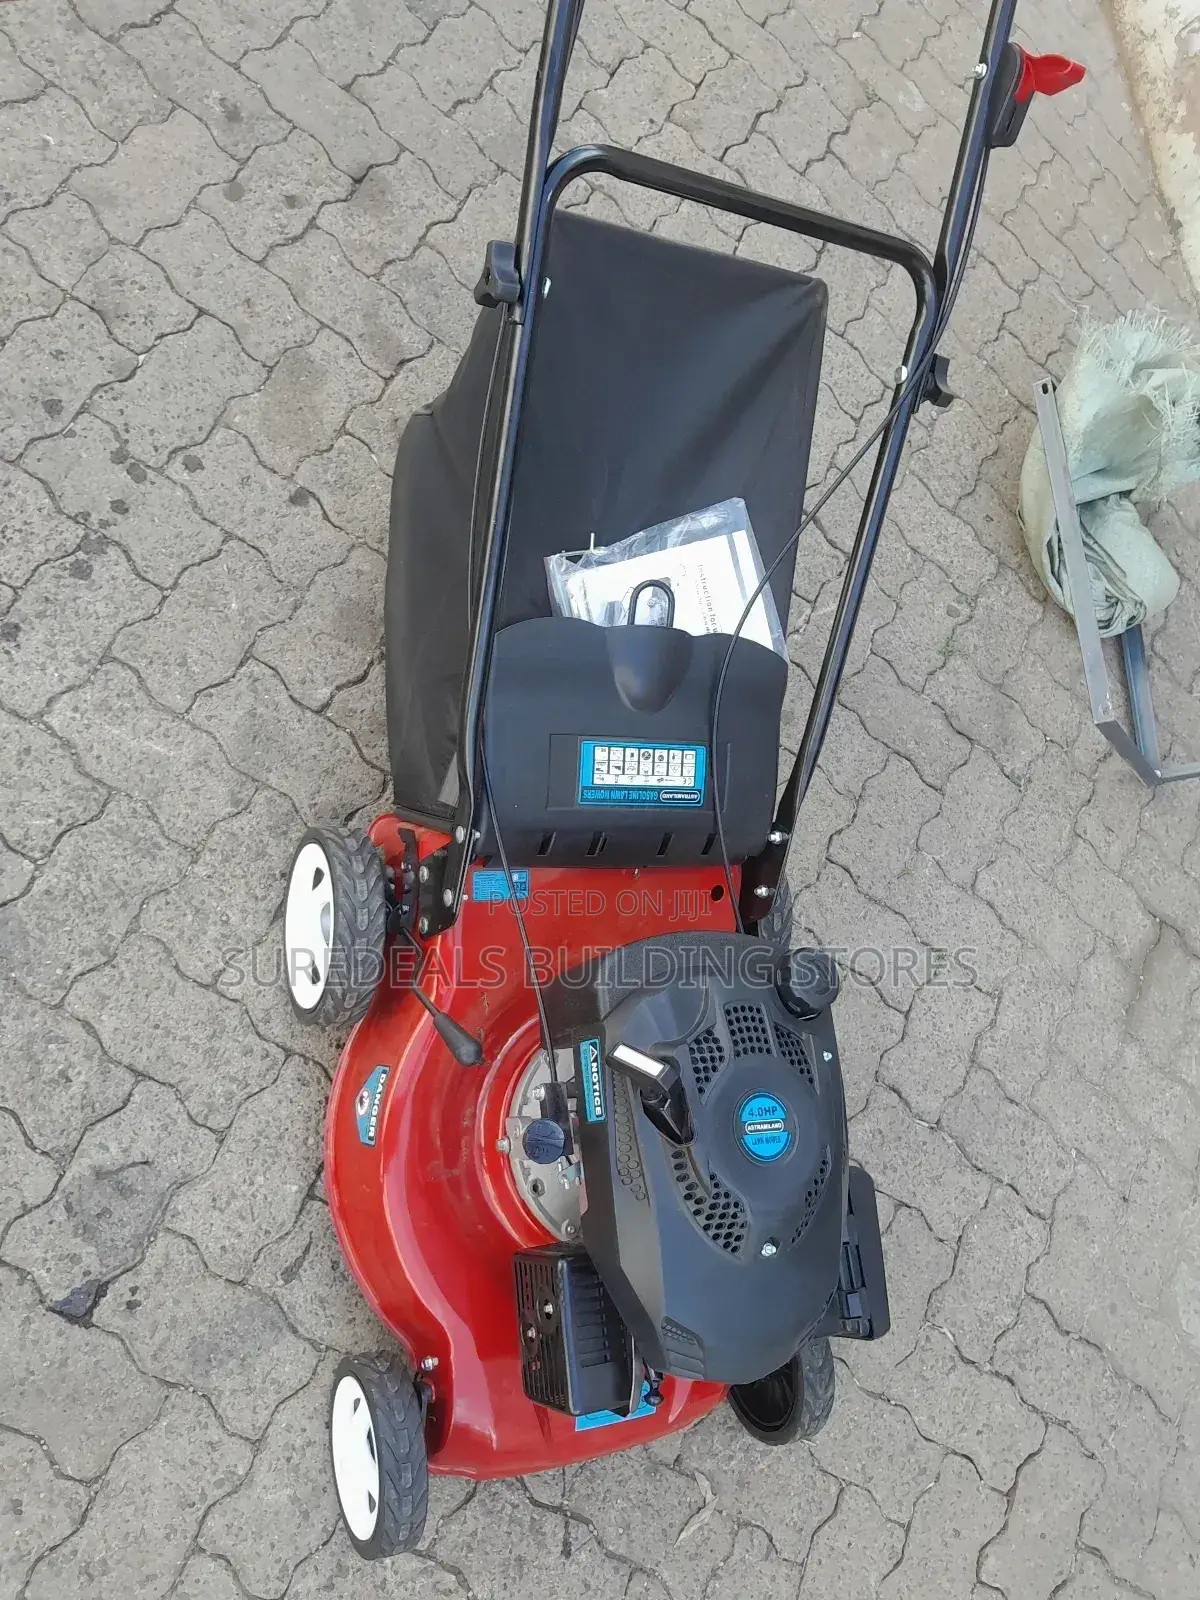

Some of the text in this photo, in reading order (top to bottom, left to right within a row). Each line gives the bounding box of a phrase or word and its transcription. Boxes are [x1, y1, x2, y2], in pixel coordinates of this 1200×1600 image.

[698, 564, 713, 612] Instruction
[709, 613, 717, 626] for
[583, 789, 609, 799] MOWERS
[610, 790, 628, 799] LAWN
[628, 791, 658, 800] GASOLINE
[591, 1062, 602, 1116] NOTICE
[368, 1073, 386, 1137] DANGER
[748, 1106, 778, 1117] 4.0HP
[747, 1122, 782, 1131] ASTRAMILAND
